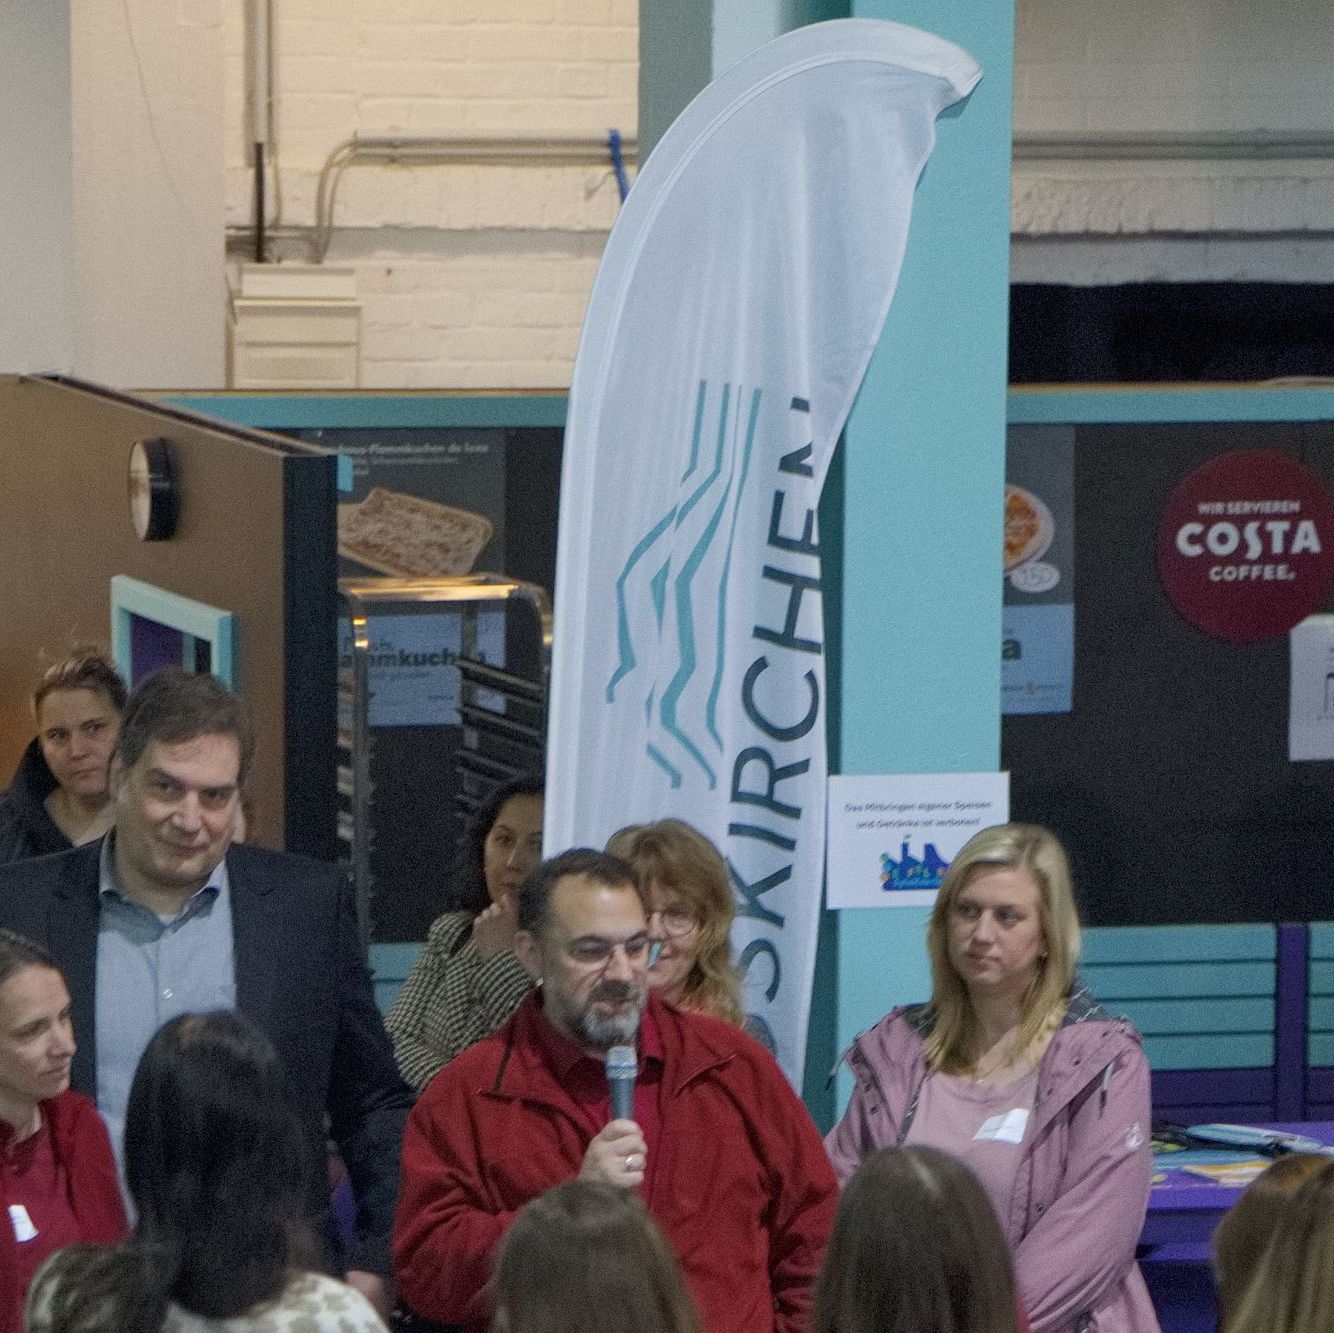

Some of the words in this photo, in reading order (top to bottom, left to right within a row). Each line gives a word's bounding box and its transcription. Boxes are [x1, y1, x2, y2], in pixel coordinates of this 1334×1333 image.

[1198, 501, 1226, 516] WIR
[1227, 500, 1300, 516] SERVIEREN
[1175, 519, 1321, 560] COSTA
